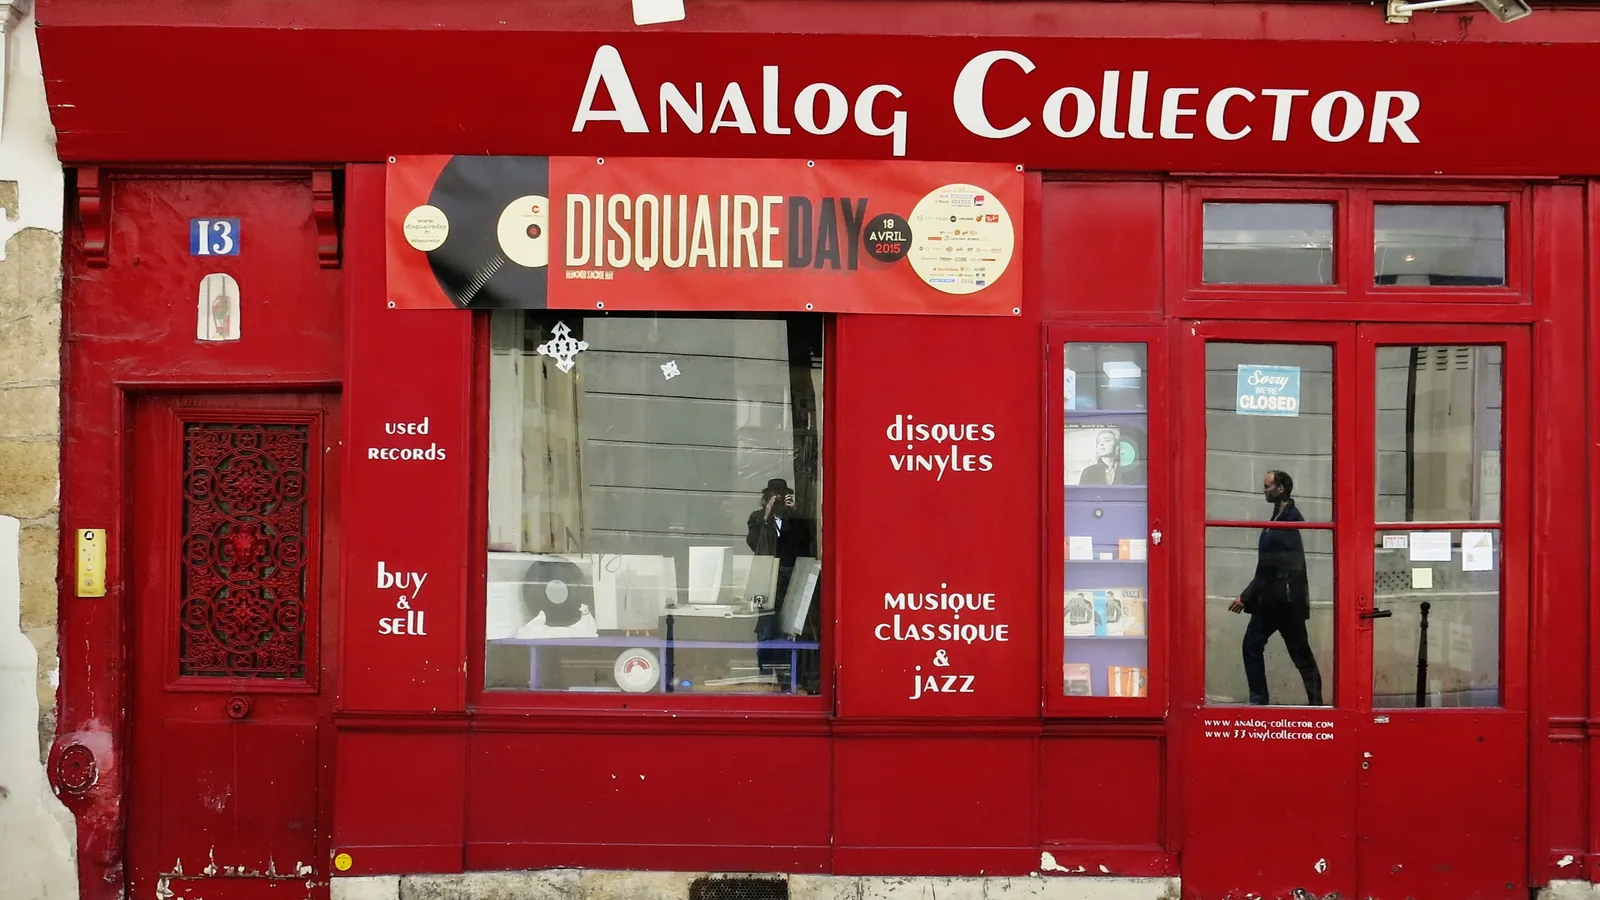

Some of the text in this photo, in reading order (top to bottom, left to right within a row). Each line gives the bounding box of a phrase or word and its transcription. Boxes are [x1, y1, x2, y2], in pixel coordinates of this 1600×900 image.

[571, 44, 1421, 156] Analog Collector
[565, 193, 869, 271] DISQUAIRE DAY
[883, 218, 895, 229] 18
[198, 220, 234, 255] 13
[869, 230, 907, 242] AVRIL
[875, 243, 901, 254] 2015
[1247, 369, 1290, 391] Sorry
[1255, 387, 1279, 395] WE'RE
[1239, 394, 1298, 411] CLOSED
[385, 416, 429, 435] used
[886, 414, 996, 443] disques
[367, 442, 446, 461] records
[889, 444, 993, 481] vinyles
[376, 561, 428, 599] buy
[396, 594, 411, 610] &
[884, 582, 996, 613] musique
[378, 610, 427, 636] sell
[874, 613, 1009, 644] classique
[932, 649, 950, 667] &
[909, 665, 974, 700] jazz
